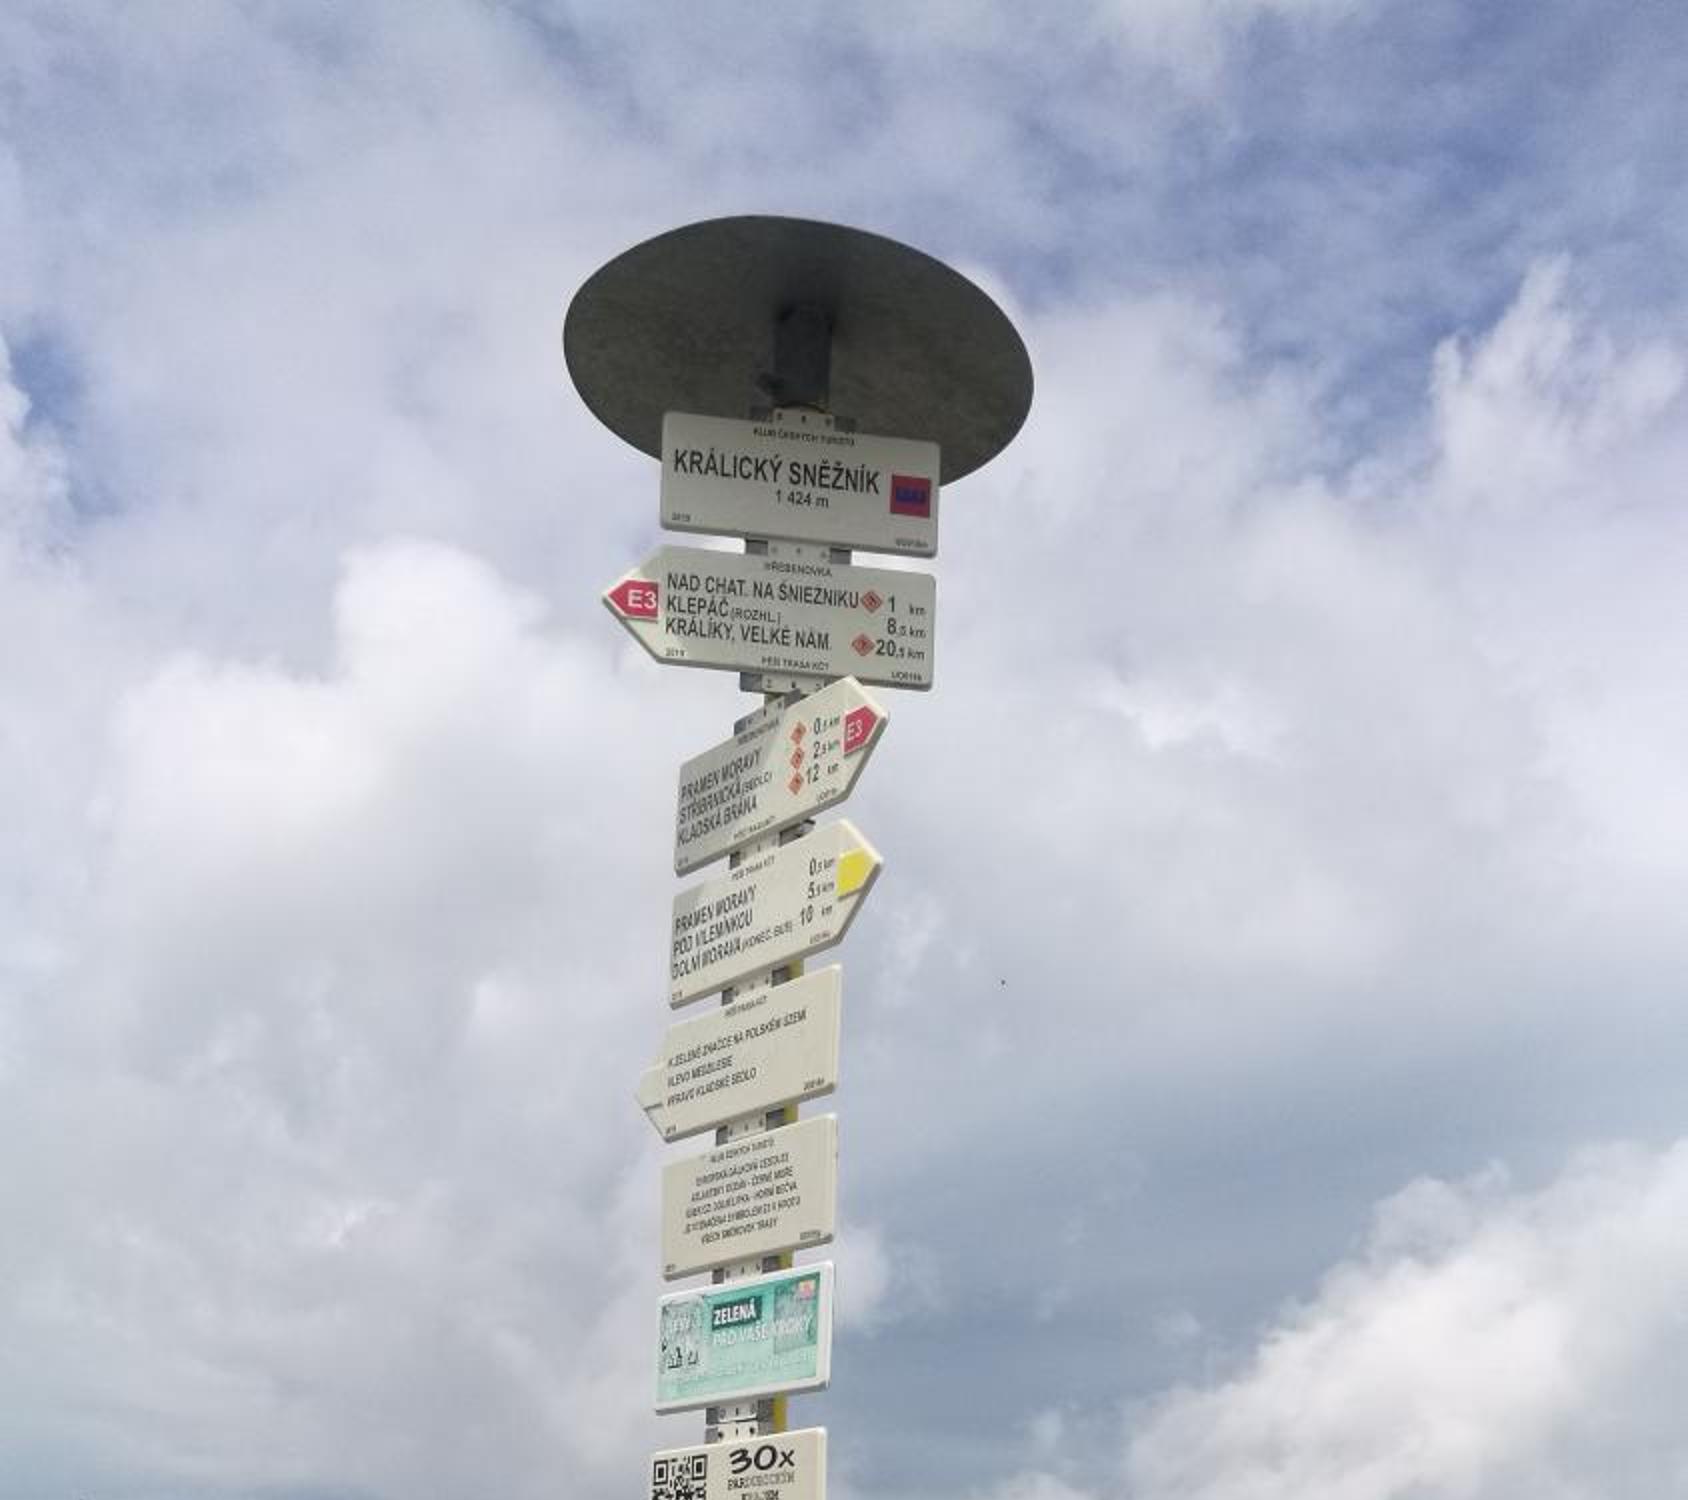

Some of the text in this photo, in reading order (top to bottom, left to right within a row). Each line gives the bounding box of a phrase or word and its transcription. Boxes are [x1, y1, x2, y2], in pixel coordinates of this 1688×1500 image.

[674, 448, 880, 494] KRÁLICKÝ SNĚŽNÍK
[776, 490, 829, 508] 1 424 m
[627, 589, 657, 609] E3
[668, 572, 700, 592] NAD
[753, 582, 774, 600] NA
[888, 596, 896, 613] 1
[908, 604, 926, 616] km
[667, 593, 729, 618] KLEPÁČ
[909, 626, 926, 638] km
[740, 623, 790, 646] VELKÉ
[908, 648, 926, 660] km
[676, 905, 712, 936] PRAMEN
[673, 936, 692, 956] POD
[714, 1299, 757, 1325] ZELENÁ
[729, 1445, 796, 1474] 30x
